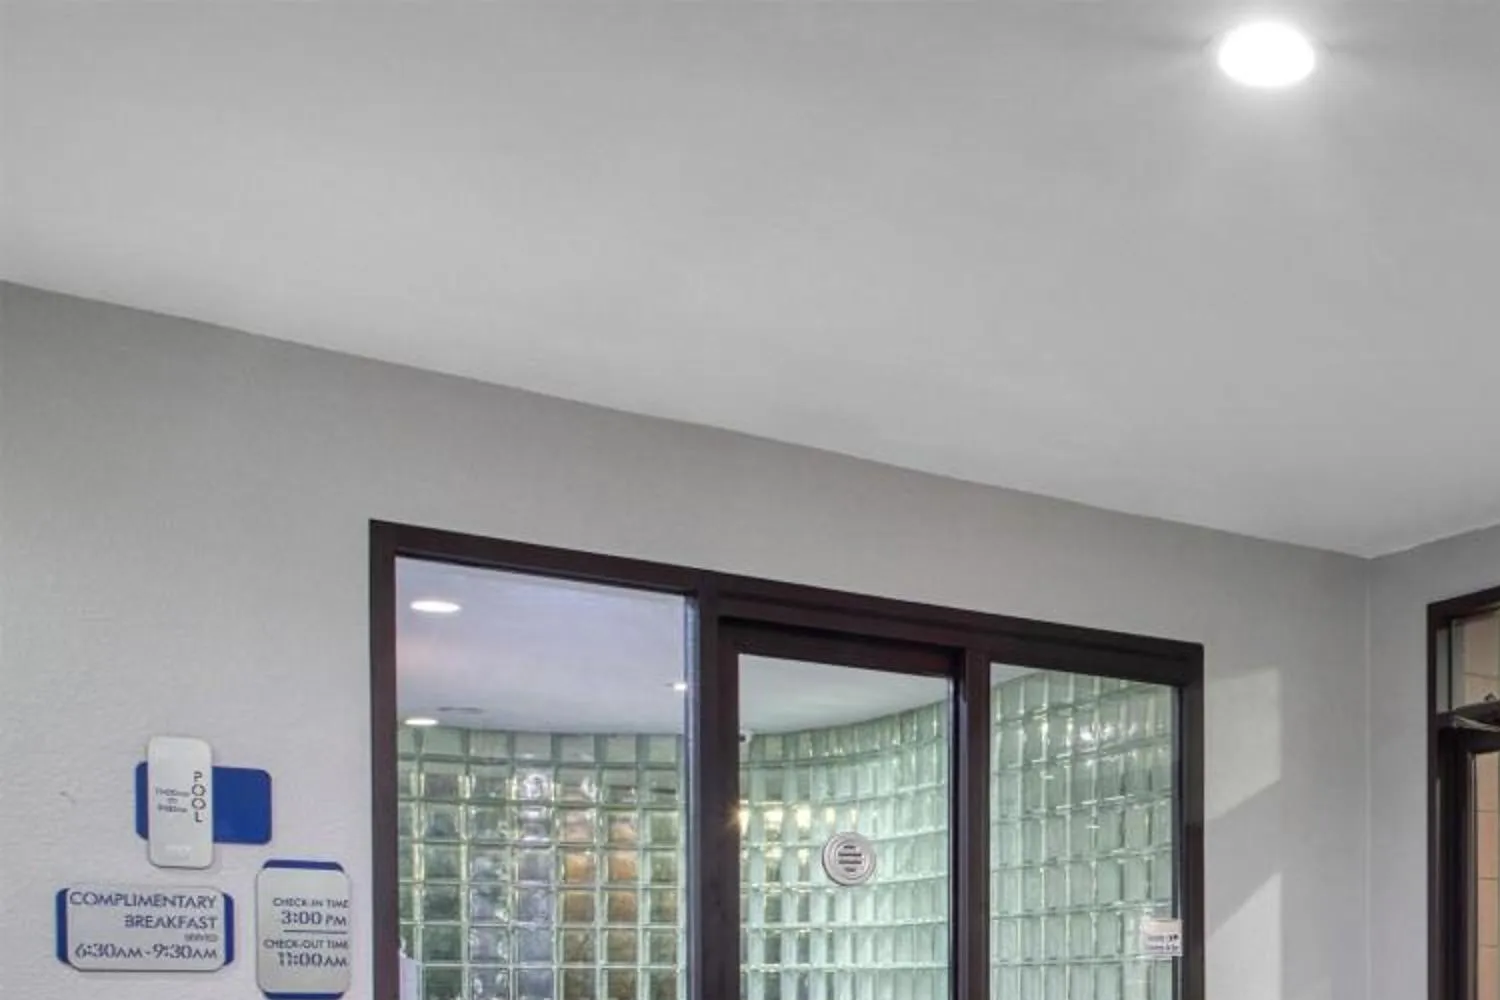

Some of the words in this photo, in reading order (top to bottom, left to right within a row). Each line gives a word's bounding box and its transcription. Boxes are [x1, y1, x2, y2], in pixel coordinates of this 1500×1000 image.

[191, 771, 207, 823] POOL
[69, 891, 217, 909] COMPLIMENTARY
[327, 899, 349, 909] TIME
[124, 914, 218, 930] BREAKFAST
[281, 910, 322, 925] 3:00
[325, 914, 347, 926] PM
[327, 939, 348, 949] TIME
